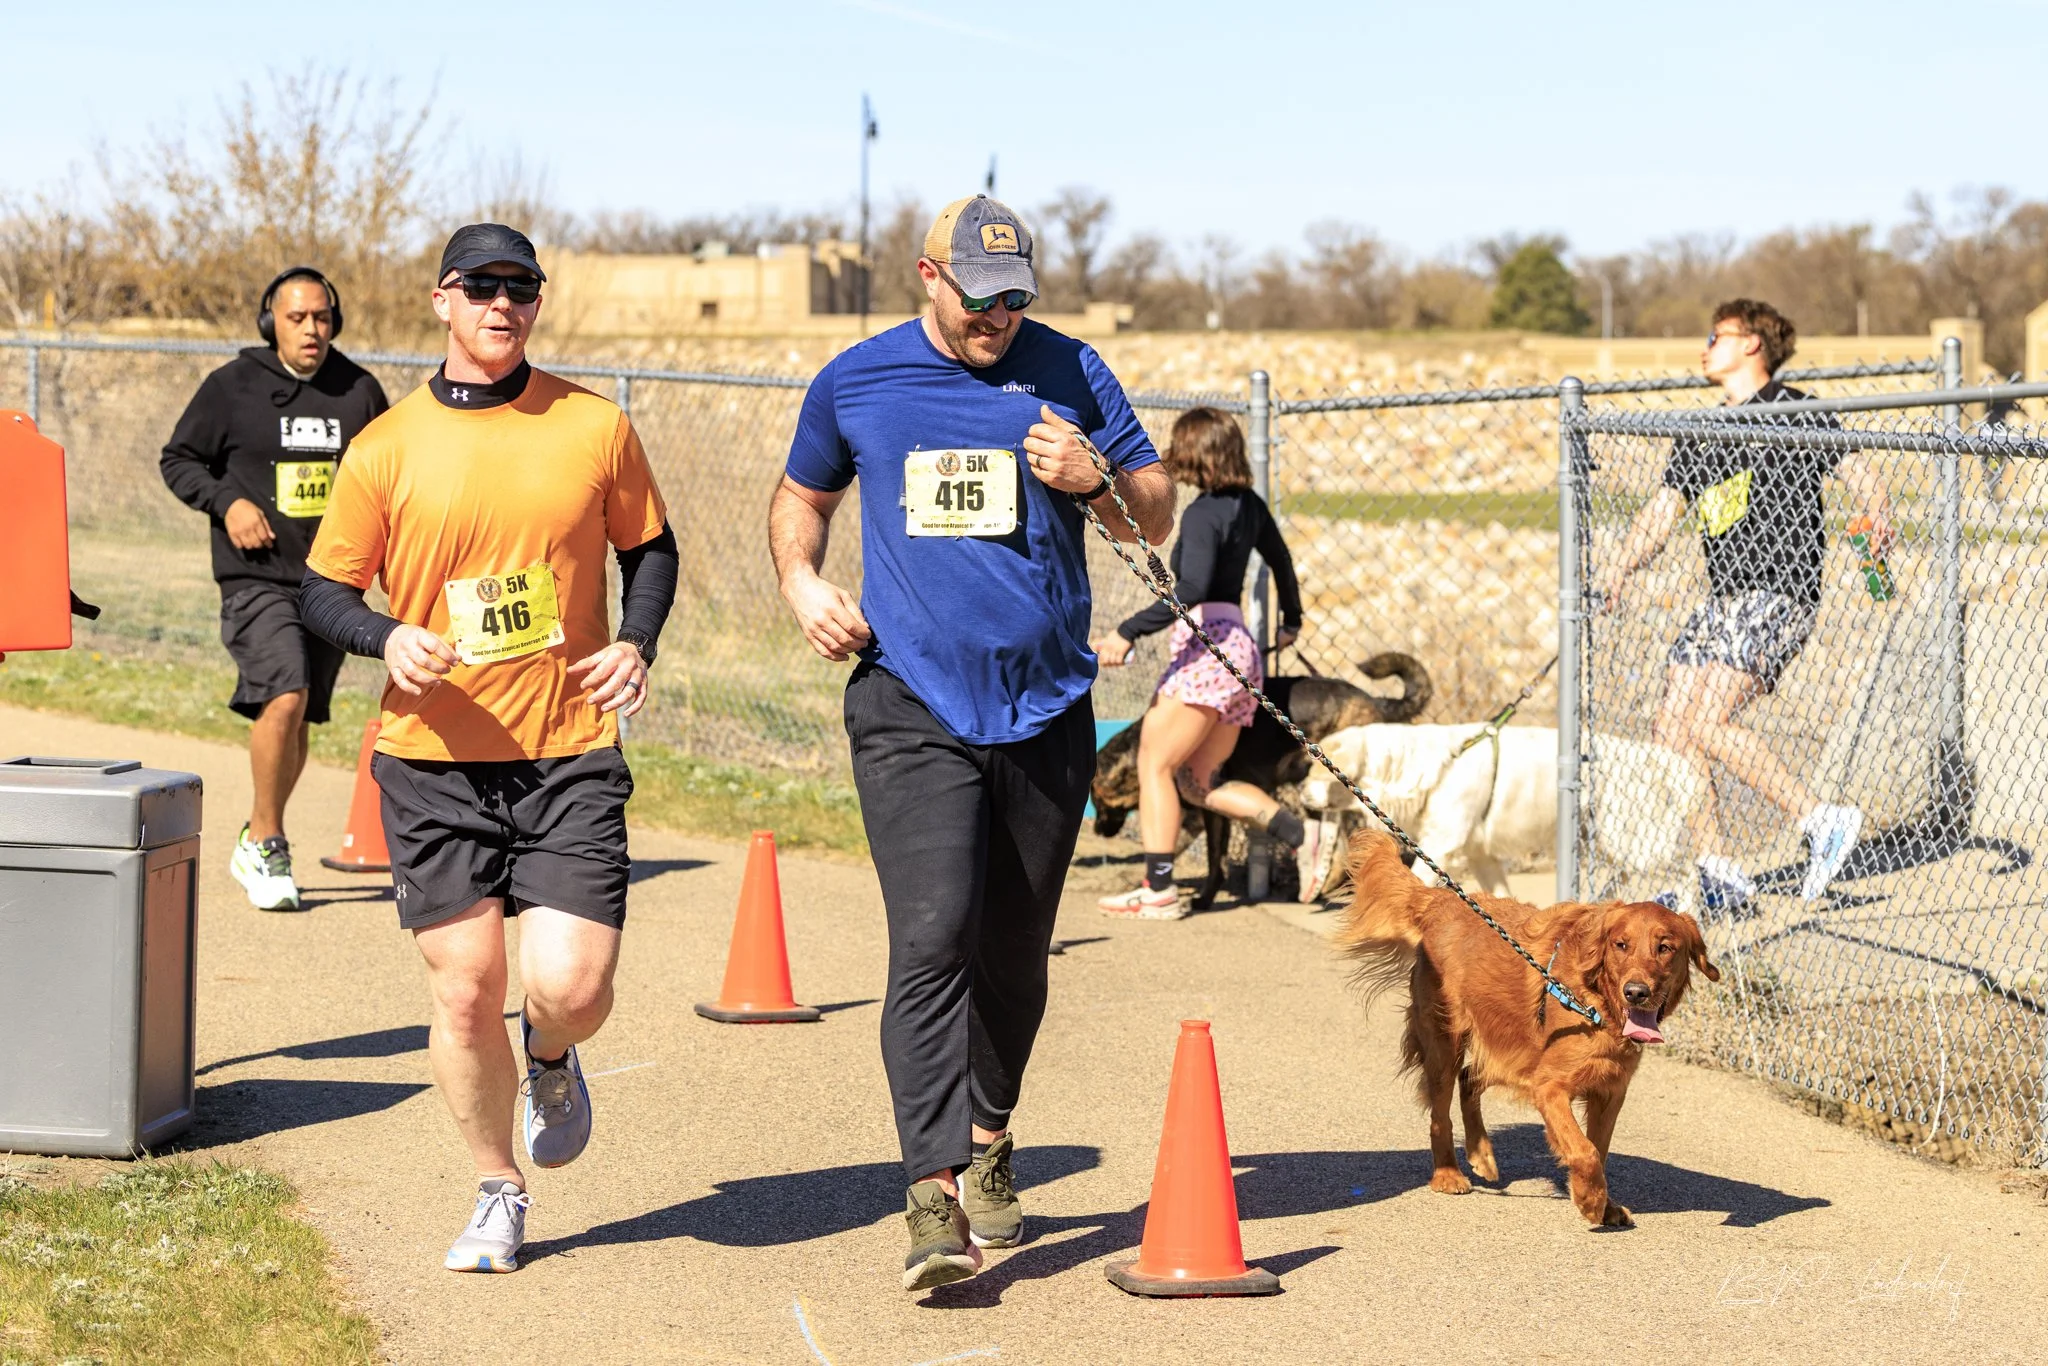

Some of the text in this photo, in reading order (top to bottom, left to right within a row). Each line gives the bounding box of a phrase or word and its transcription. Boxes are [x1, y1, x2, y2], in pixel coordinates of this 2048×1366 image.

[966, 455, 989, 473] 5K
[295, 482, 327, 500] 444
[935, 480, 985, 511] 415
[506, 573, 530, 594] 5K
[481, 600, 531, 637] 416
[501, 643, 521, 653] Atypical
[520, 637, 542, 649] Beverage
[541, 634, 550, 642] 416
